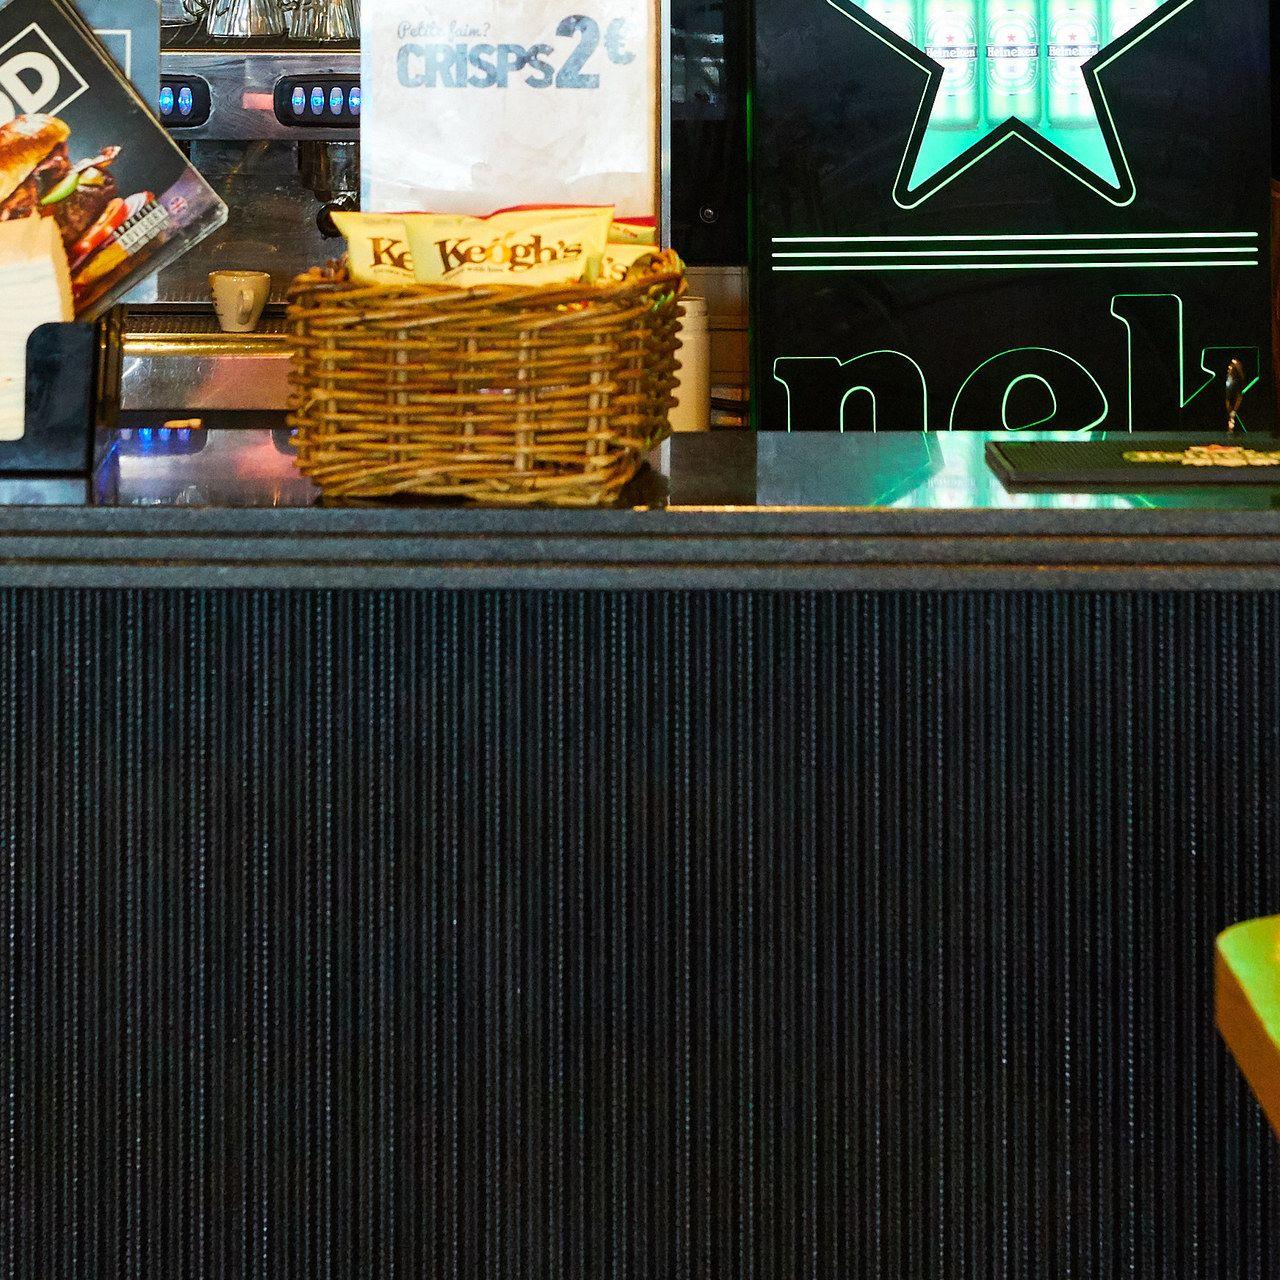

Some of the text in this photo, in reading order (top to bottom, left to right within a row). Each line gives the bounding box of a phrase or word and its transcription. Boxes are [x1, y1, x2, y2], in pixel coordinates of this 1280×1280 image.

[395, 13, 637, 91] CRISPS 2€
[925, 44, 977, 60] Heineken
[986, 44, 1039, 60] Heineken
[434, 230, 583, 276] Keogh's
